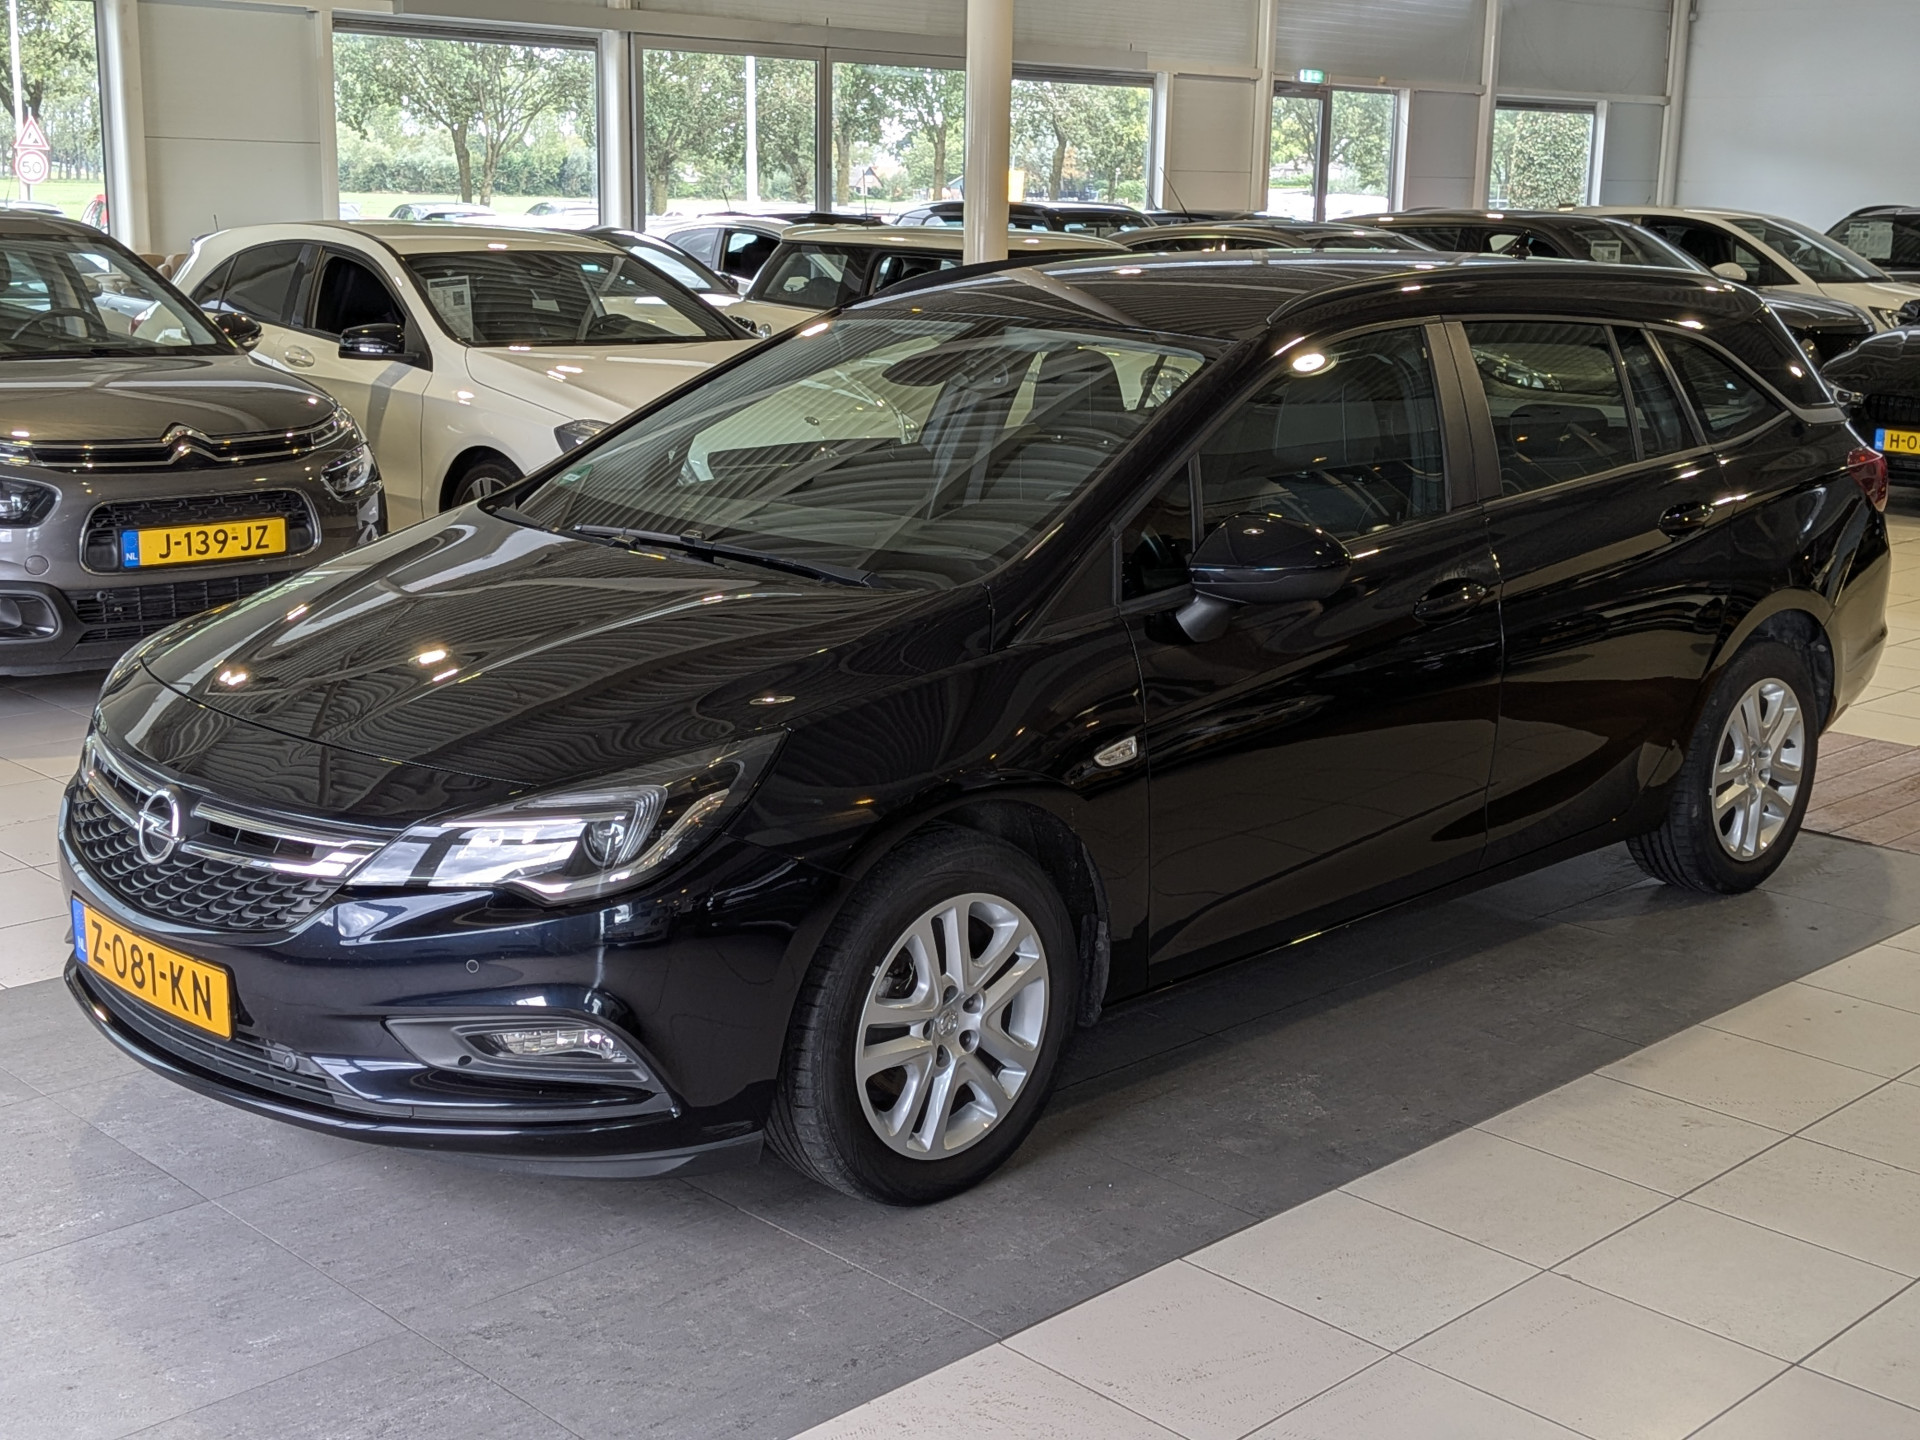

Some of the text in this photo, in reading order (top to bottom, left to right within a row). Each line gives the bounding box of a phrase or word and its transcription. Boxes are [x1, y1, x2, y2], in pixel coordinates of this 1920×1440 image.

[22, 161, 42, 174] 50
[1889, 433, 1920, 450] H-0
[159, 525, 269, 559] J-139-JZ
[126, 552, 138, 561] NL
[77, 935, 87, 953] NL
[92, 919, 212, 1022] Z-081-KN
